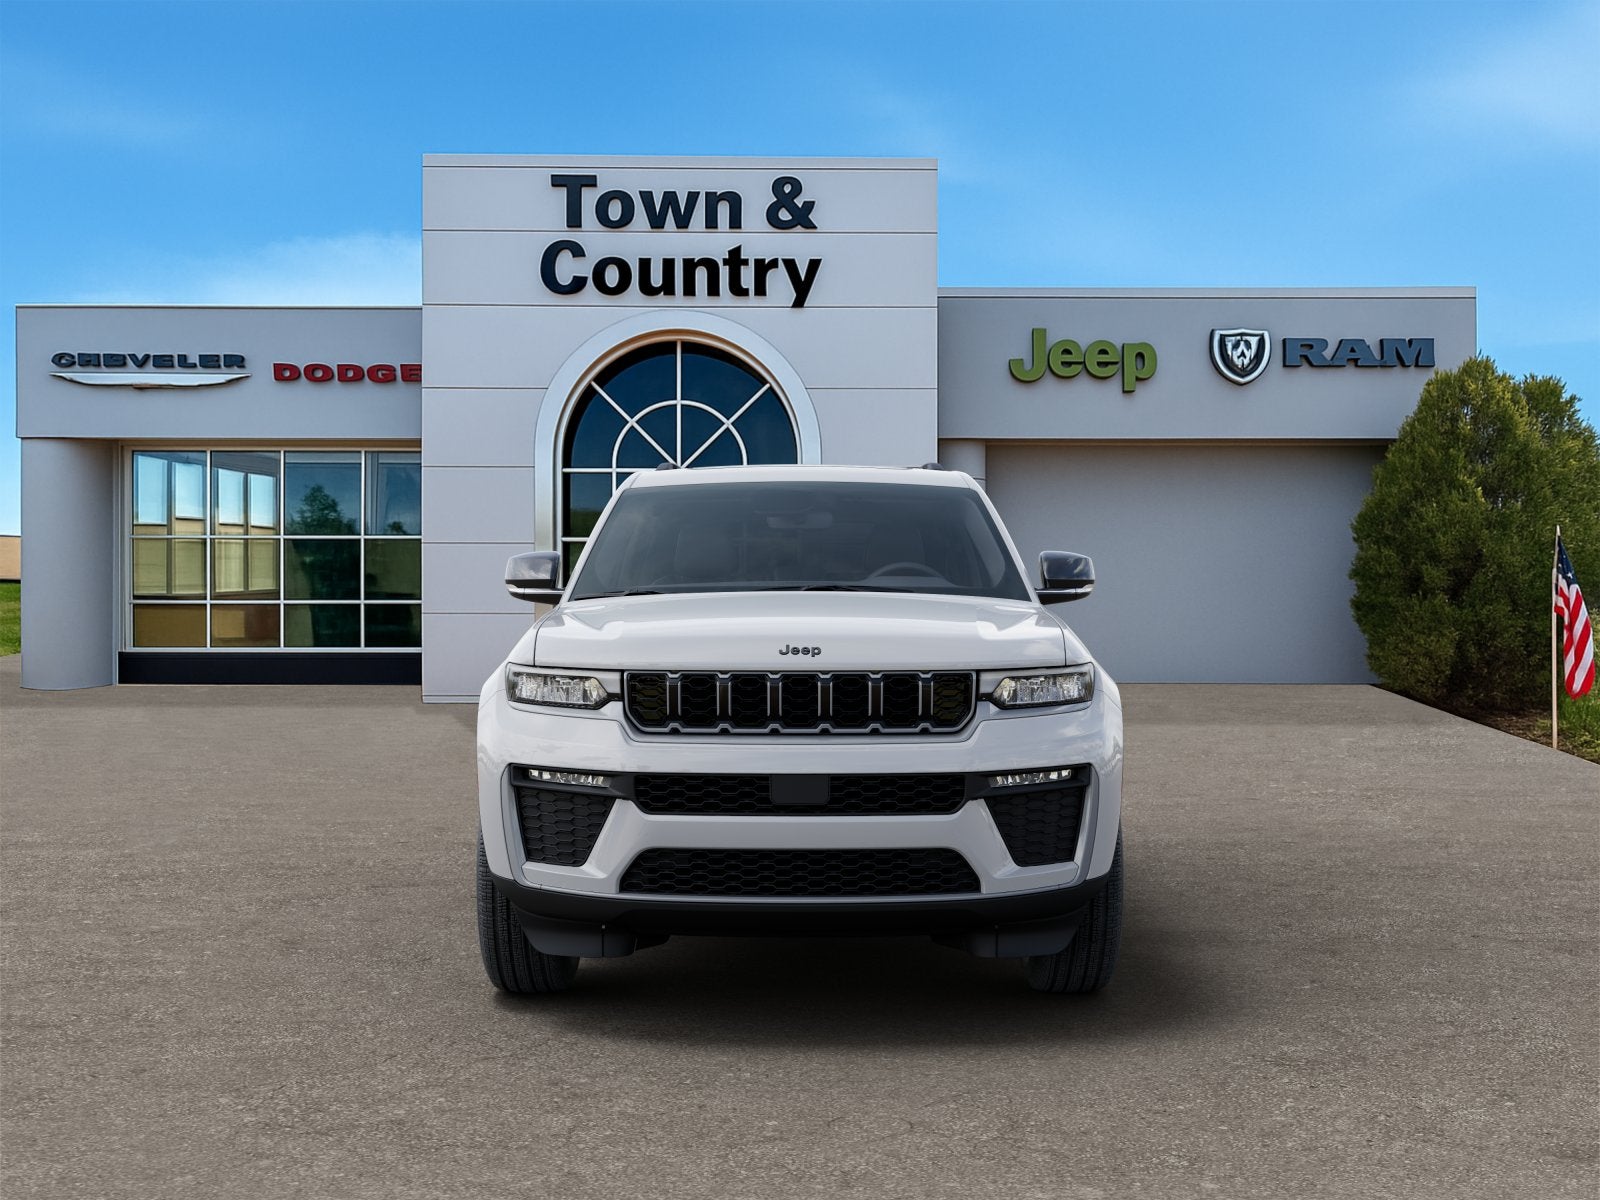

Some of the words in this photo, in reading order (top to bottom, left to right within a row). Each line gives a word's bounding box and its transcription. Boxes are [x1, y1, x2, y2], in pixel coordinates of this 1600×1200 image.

[550, 174, 742, 229] Town
[765, 175, 818, 230] &
[539, 239, 822, 308] Country
[273, 363, 422, 383] DODGE
[1009, 328, 1157, 392] Jeep
[1283, 338, 1436, 367] RAM
[779, 644, 821, 657] Jeep
